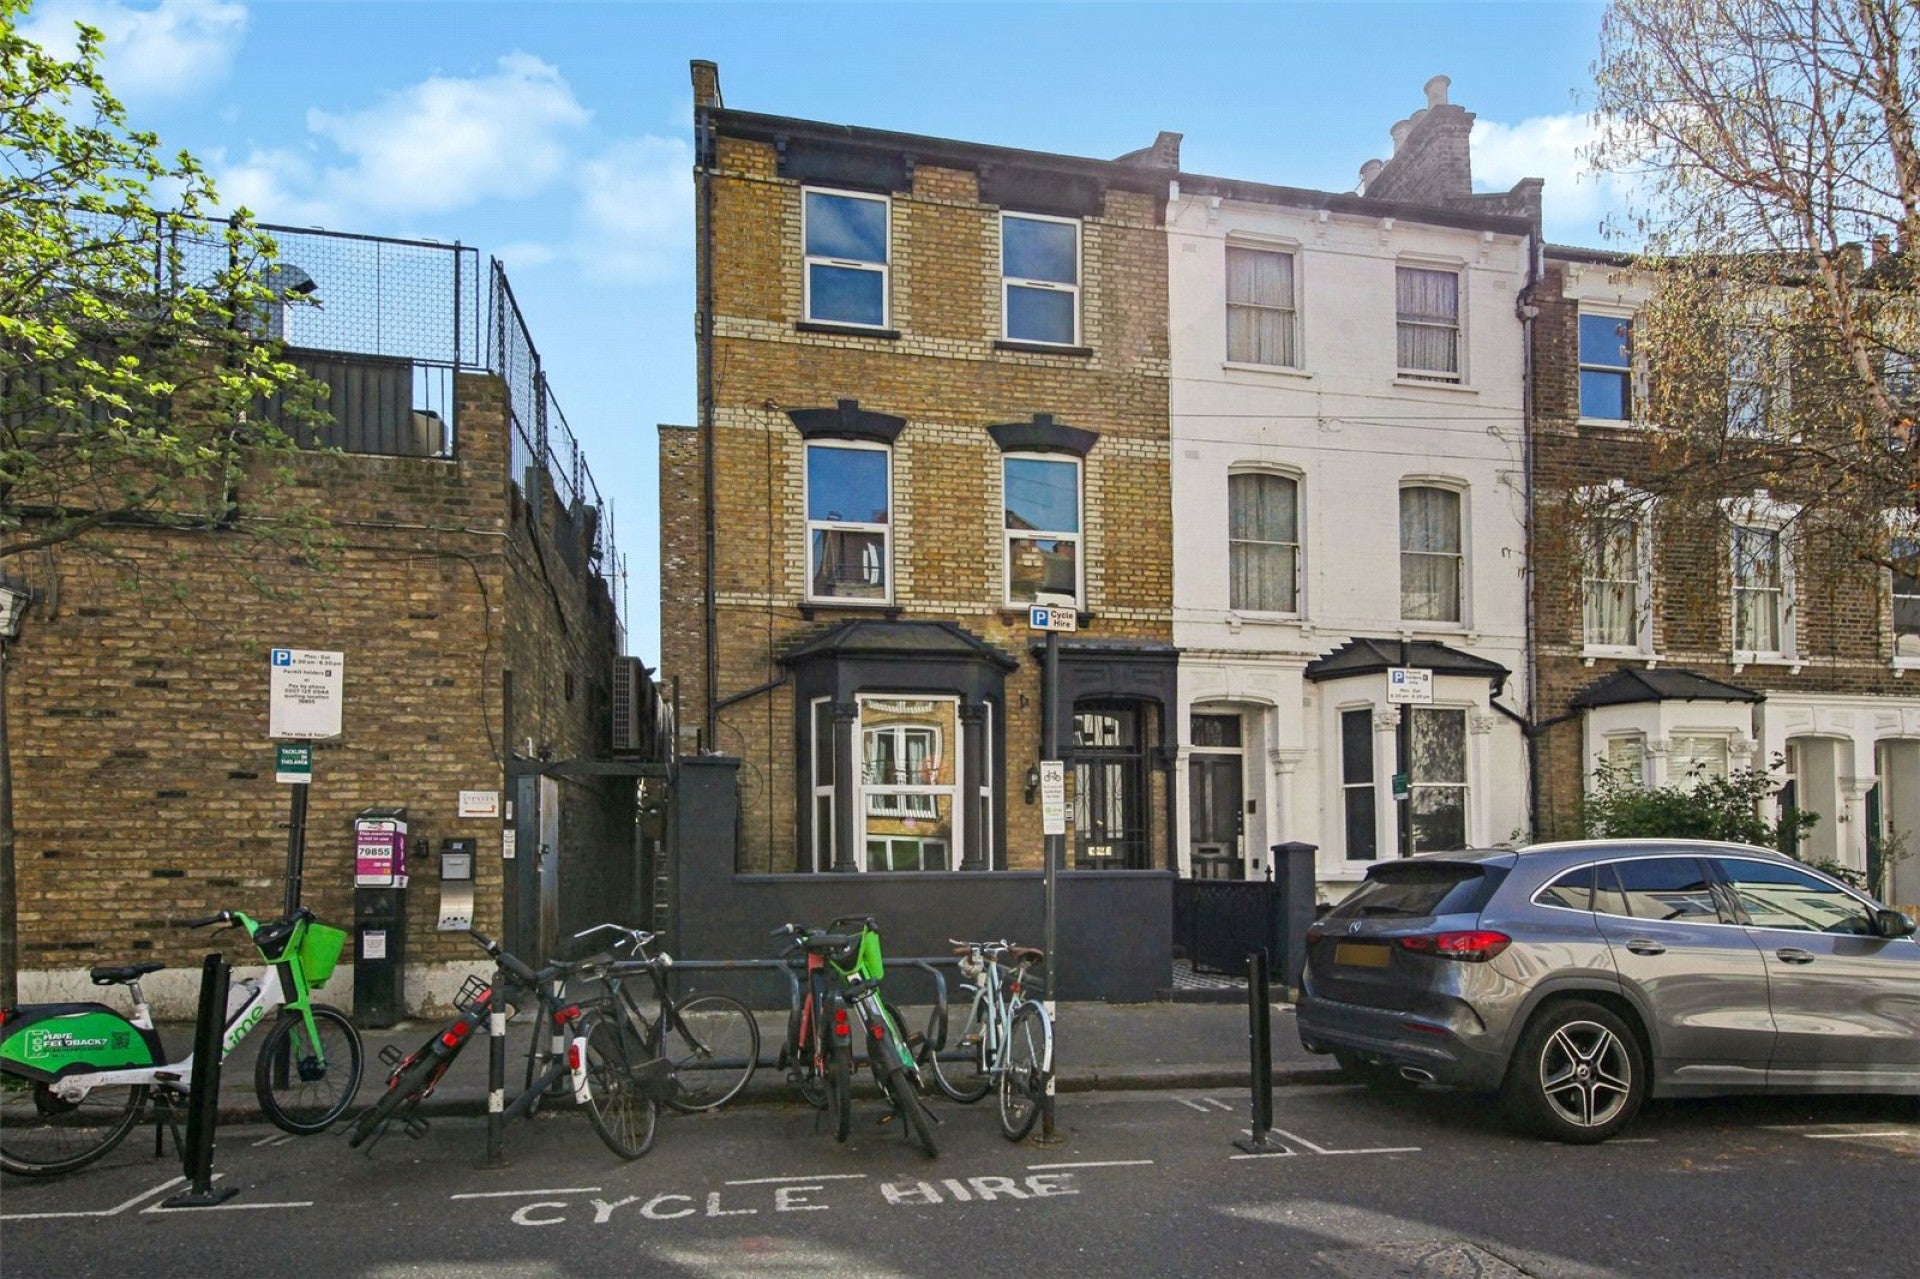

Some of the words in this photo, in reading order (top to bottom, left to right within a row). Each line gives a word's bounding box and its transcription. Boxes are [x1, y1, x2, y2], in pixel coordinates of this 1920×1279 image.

[1036, 611, 1046, 624] P
[1050, 610, 1074, 619] Cycle
[1054, 620, 1070, 628] Hire
[276, 652, 288, 665] P
[1395, 672, 1403, 682] P
[360, 847, 390, 856] 79855
[44, 1032, 73, 1040] HAVE
[511, 1186, 829, 1226] CYCLE
[880, 1173, 1080, 1205] HIRE
